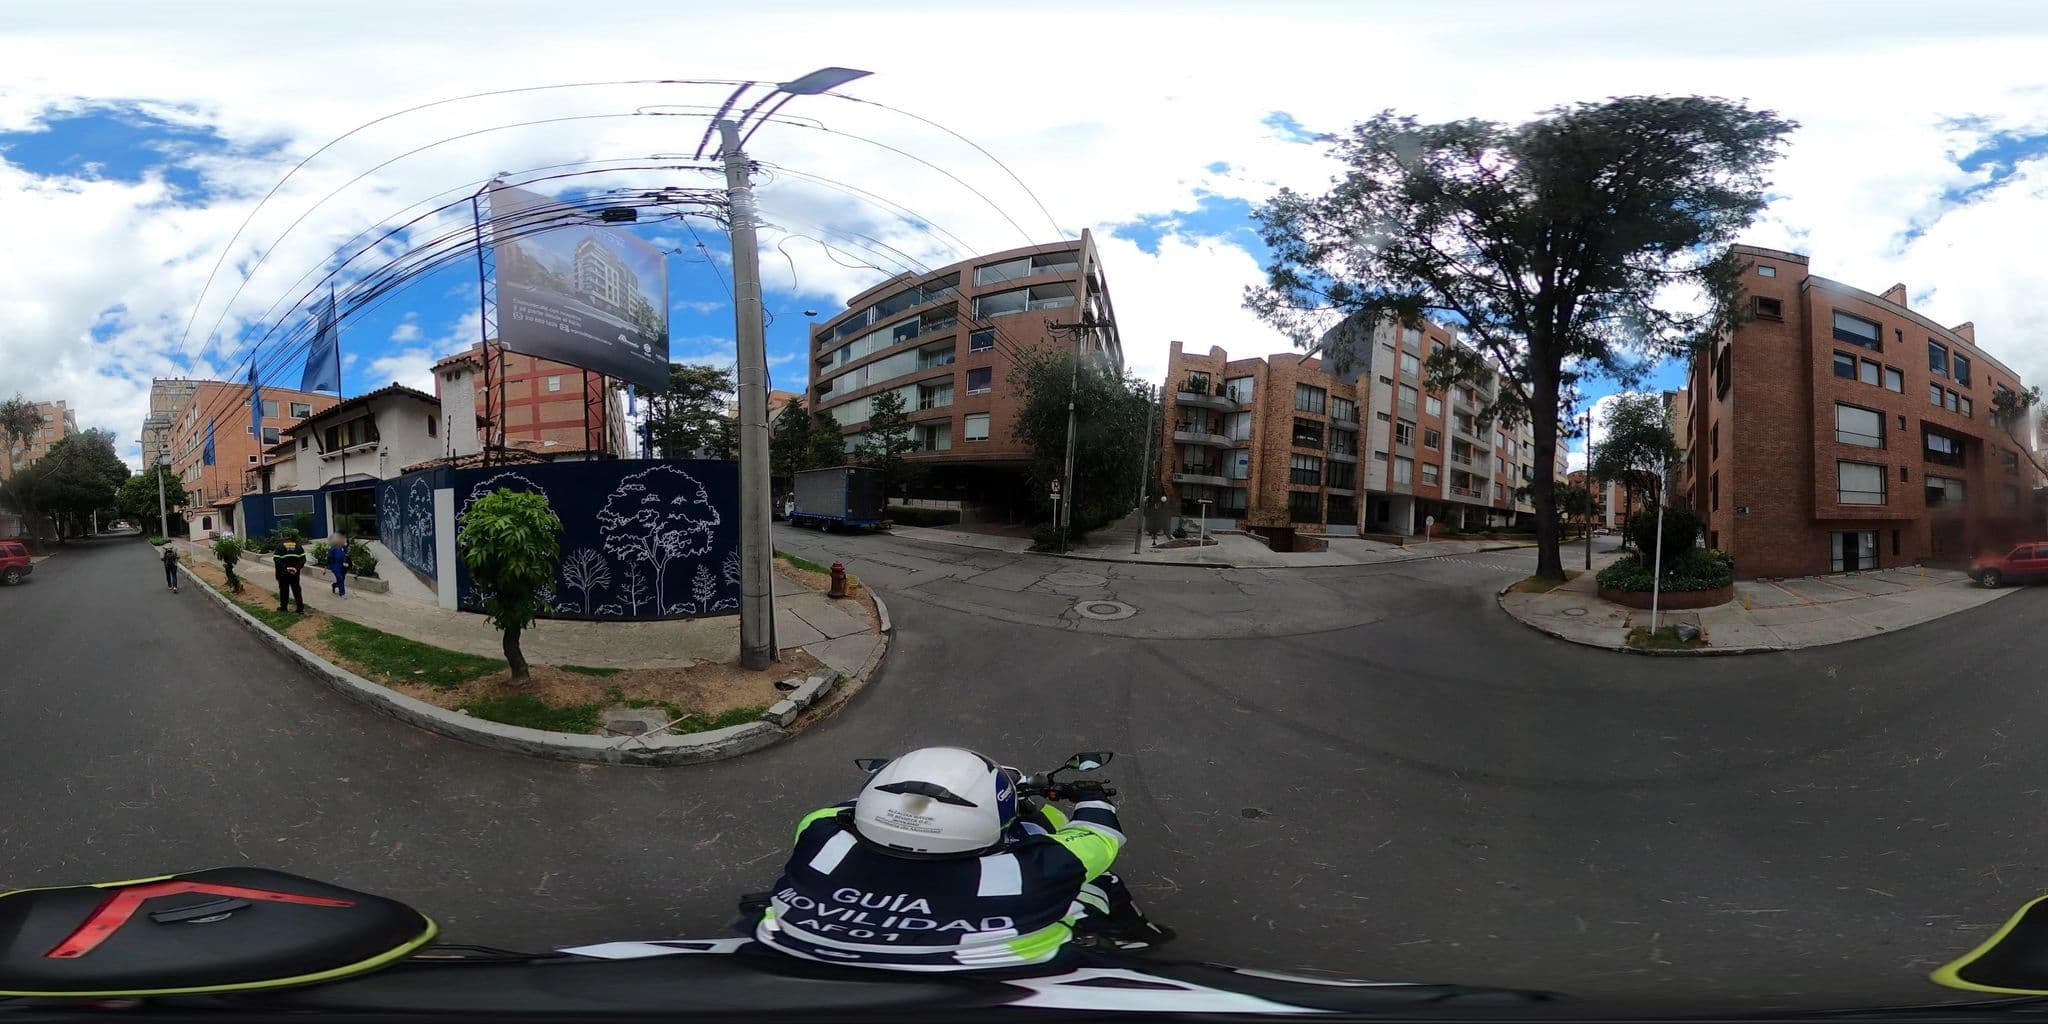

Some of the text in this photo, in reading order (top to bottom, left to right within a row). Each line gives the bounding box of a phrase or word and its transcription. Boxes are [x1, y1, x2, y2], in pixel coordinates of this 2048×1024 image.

[776, 887, 1015, 933] MOVILIDAD
[832, 887, 932, 915] GUÍA
[795, 918, 900, 942] AF01
